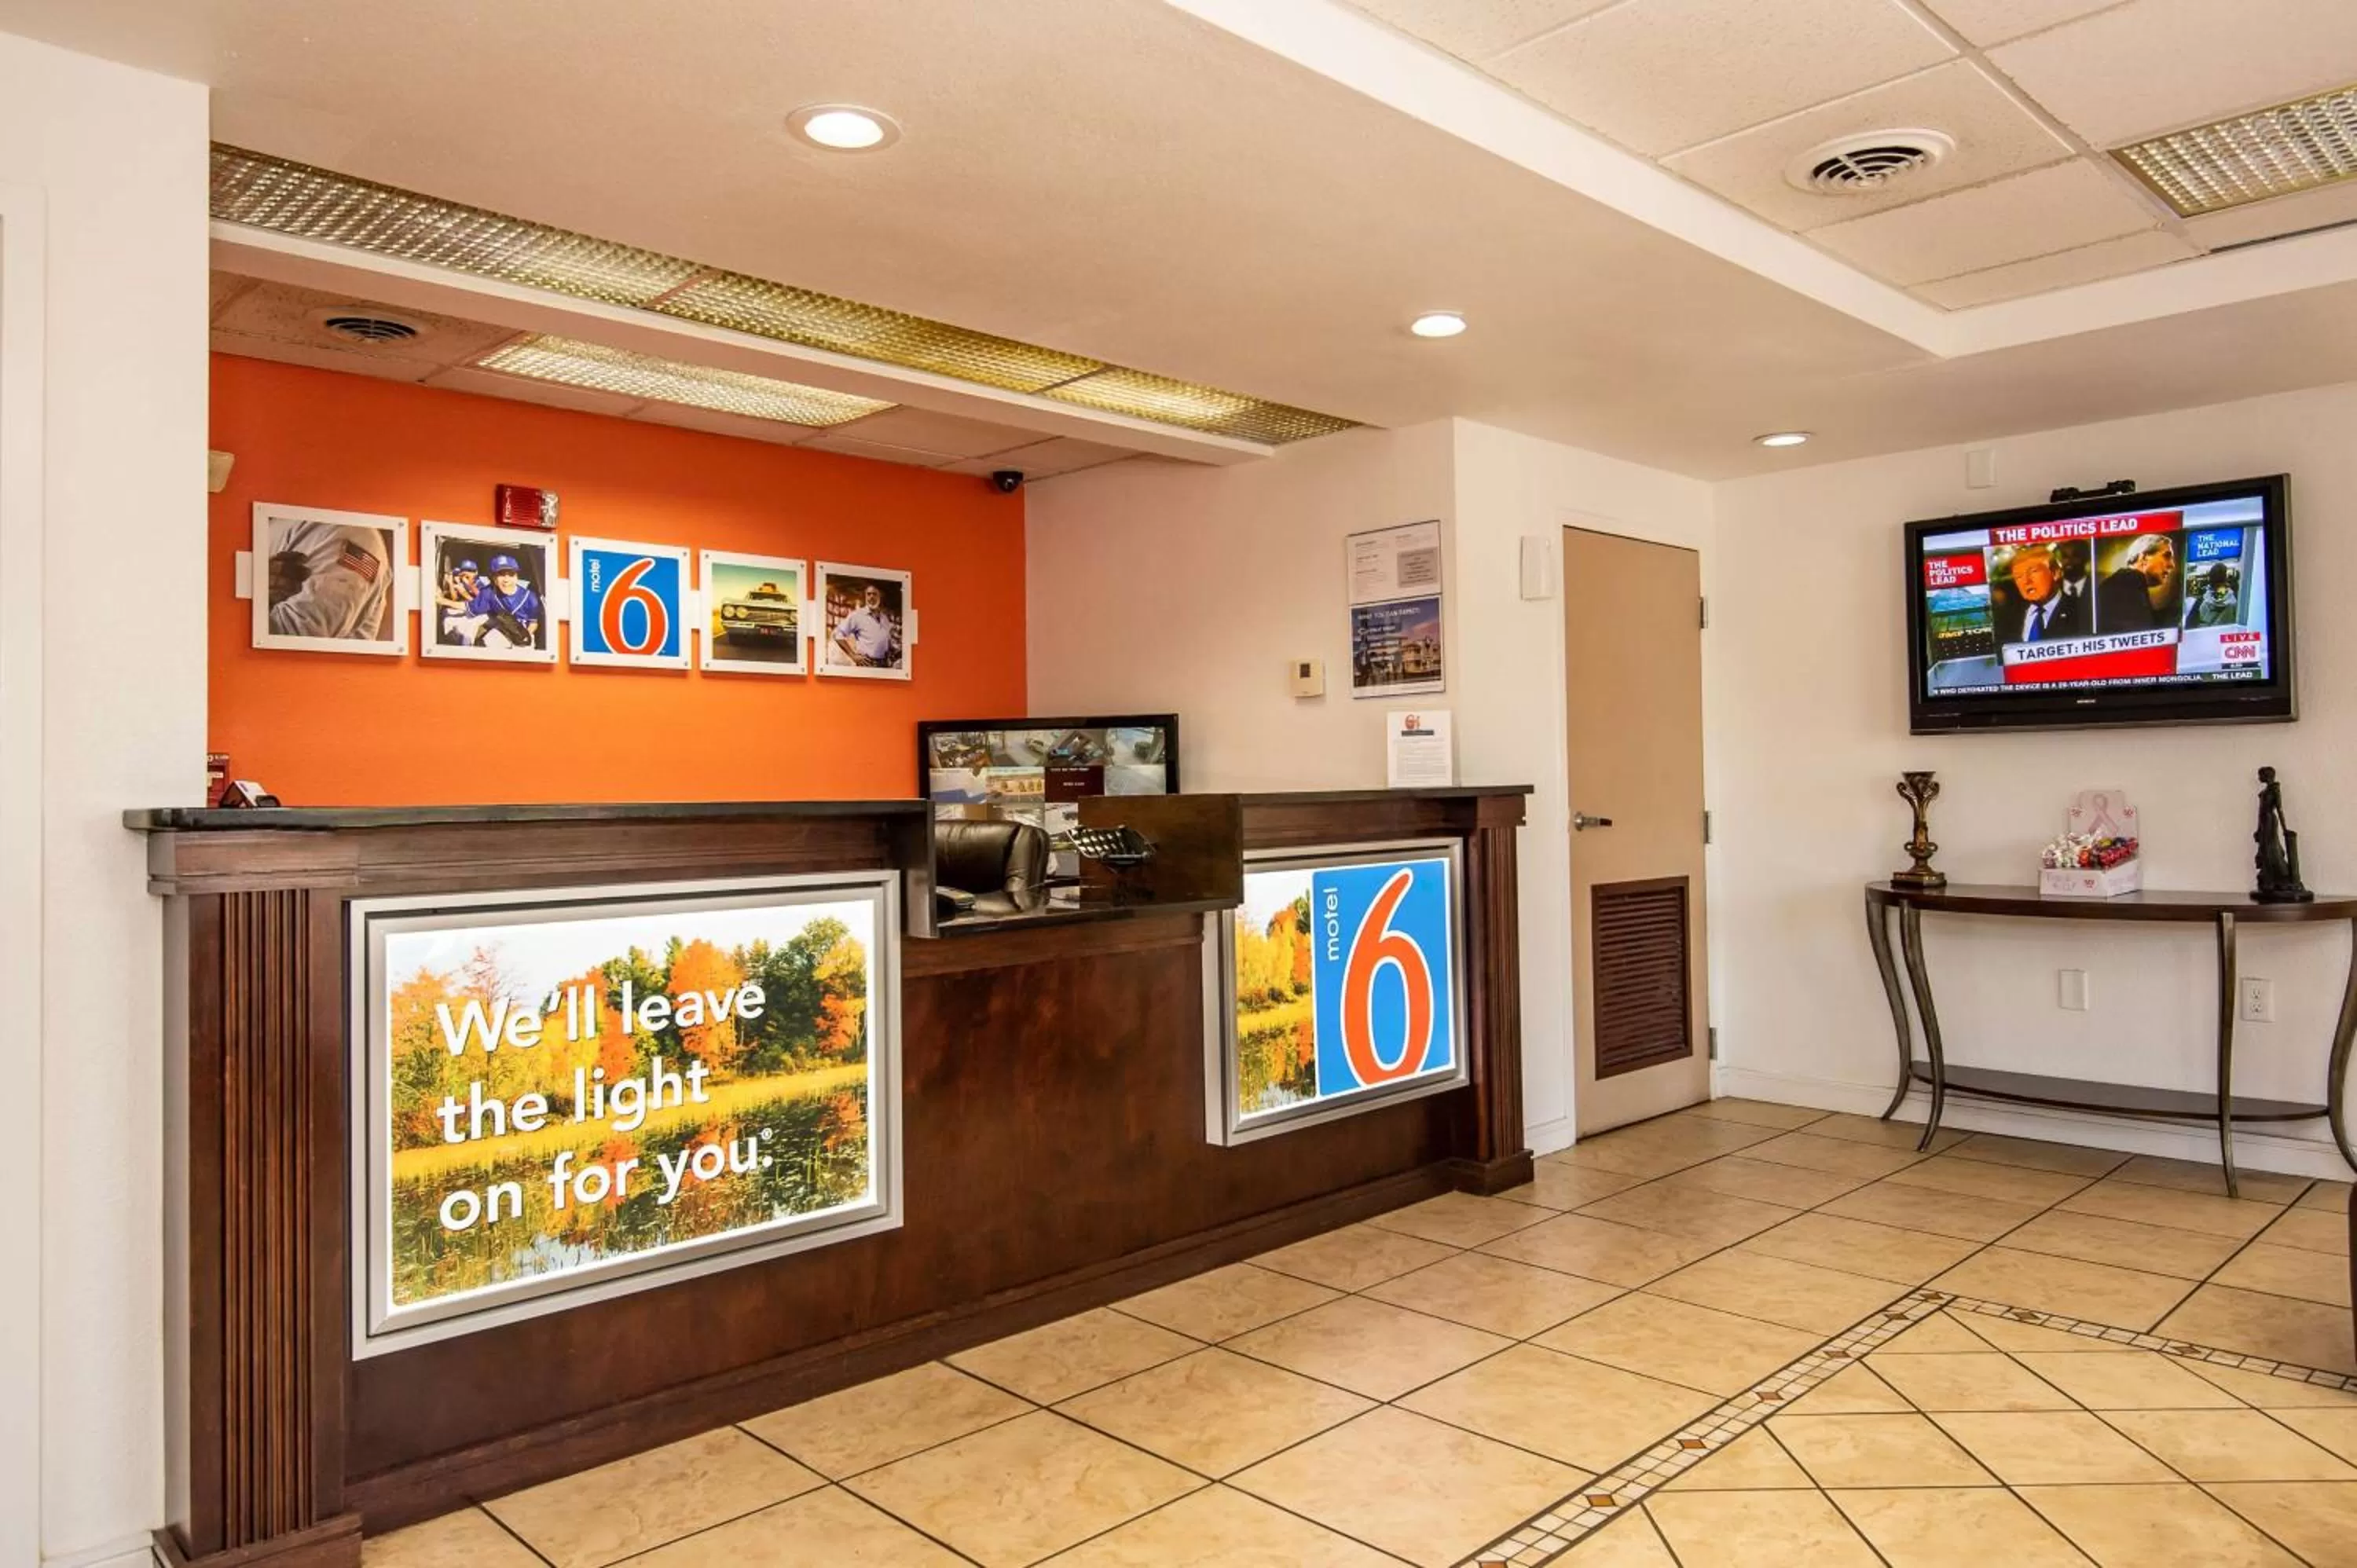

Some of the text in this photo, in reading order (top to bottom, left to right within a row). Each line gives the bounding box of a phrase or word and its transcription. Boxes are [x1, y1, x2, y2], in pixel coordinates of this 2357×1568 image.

[1996, 518, 2138, 543] THE POLITICS LEAD
[2197, 548, 2219, 558] LEAD
[2198, 540, 2239, 549] NATIONAL
[1928, 560, 1948, 570] THE
[1929, 566, 1974, 577] POLITICS
[1930, 576, 1956, 585] LEAD
[589, 558, 669, 654] motel 6
[2018, 632, 2165, 661] TARGET: HIS TWEETS
[2224, 645, 2256, 659] CNN
[2108, 678, 2131, 687] FROM
[1323, 867, 1434, 1088] motel 6
[434, 980, 767, 1057] We'll leave
[436, 1056, 710, 1144] the light
[438, 1180, 523, 1231] on
[549, 1151, 639, 1210] for
